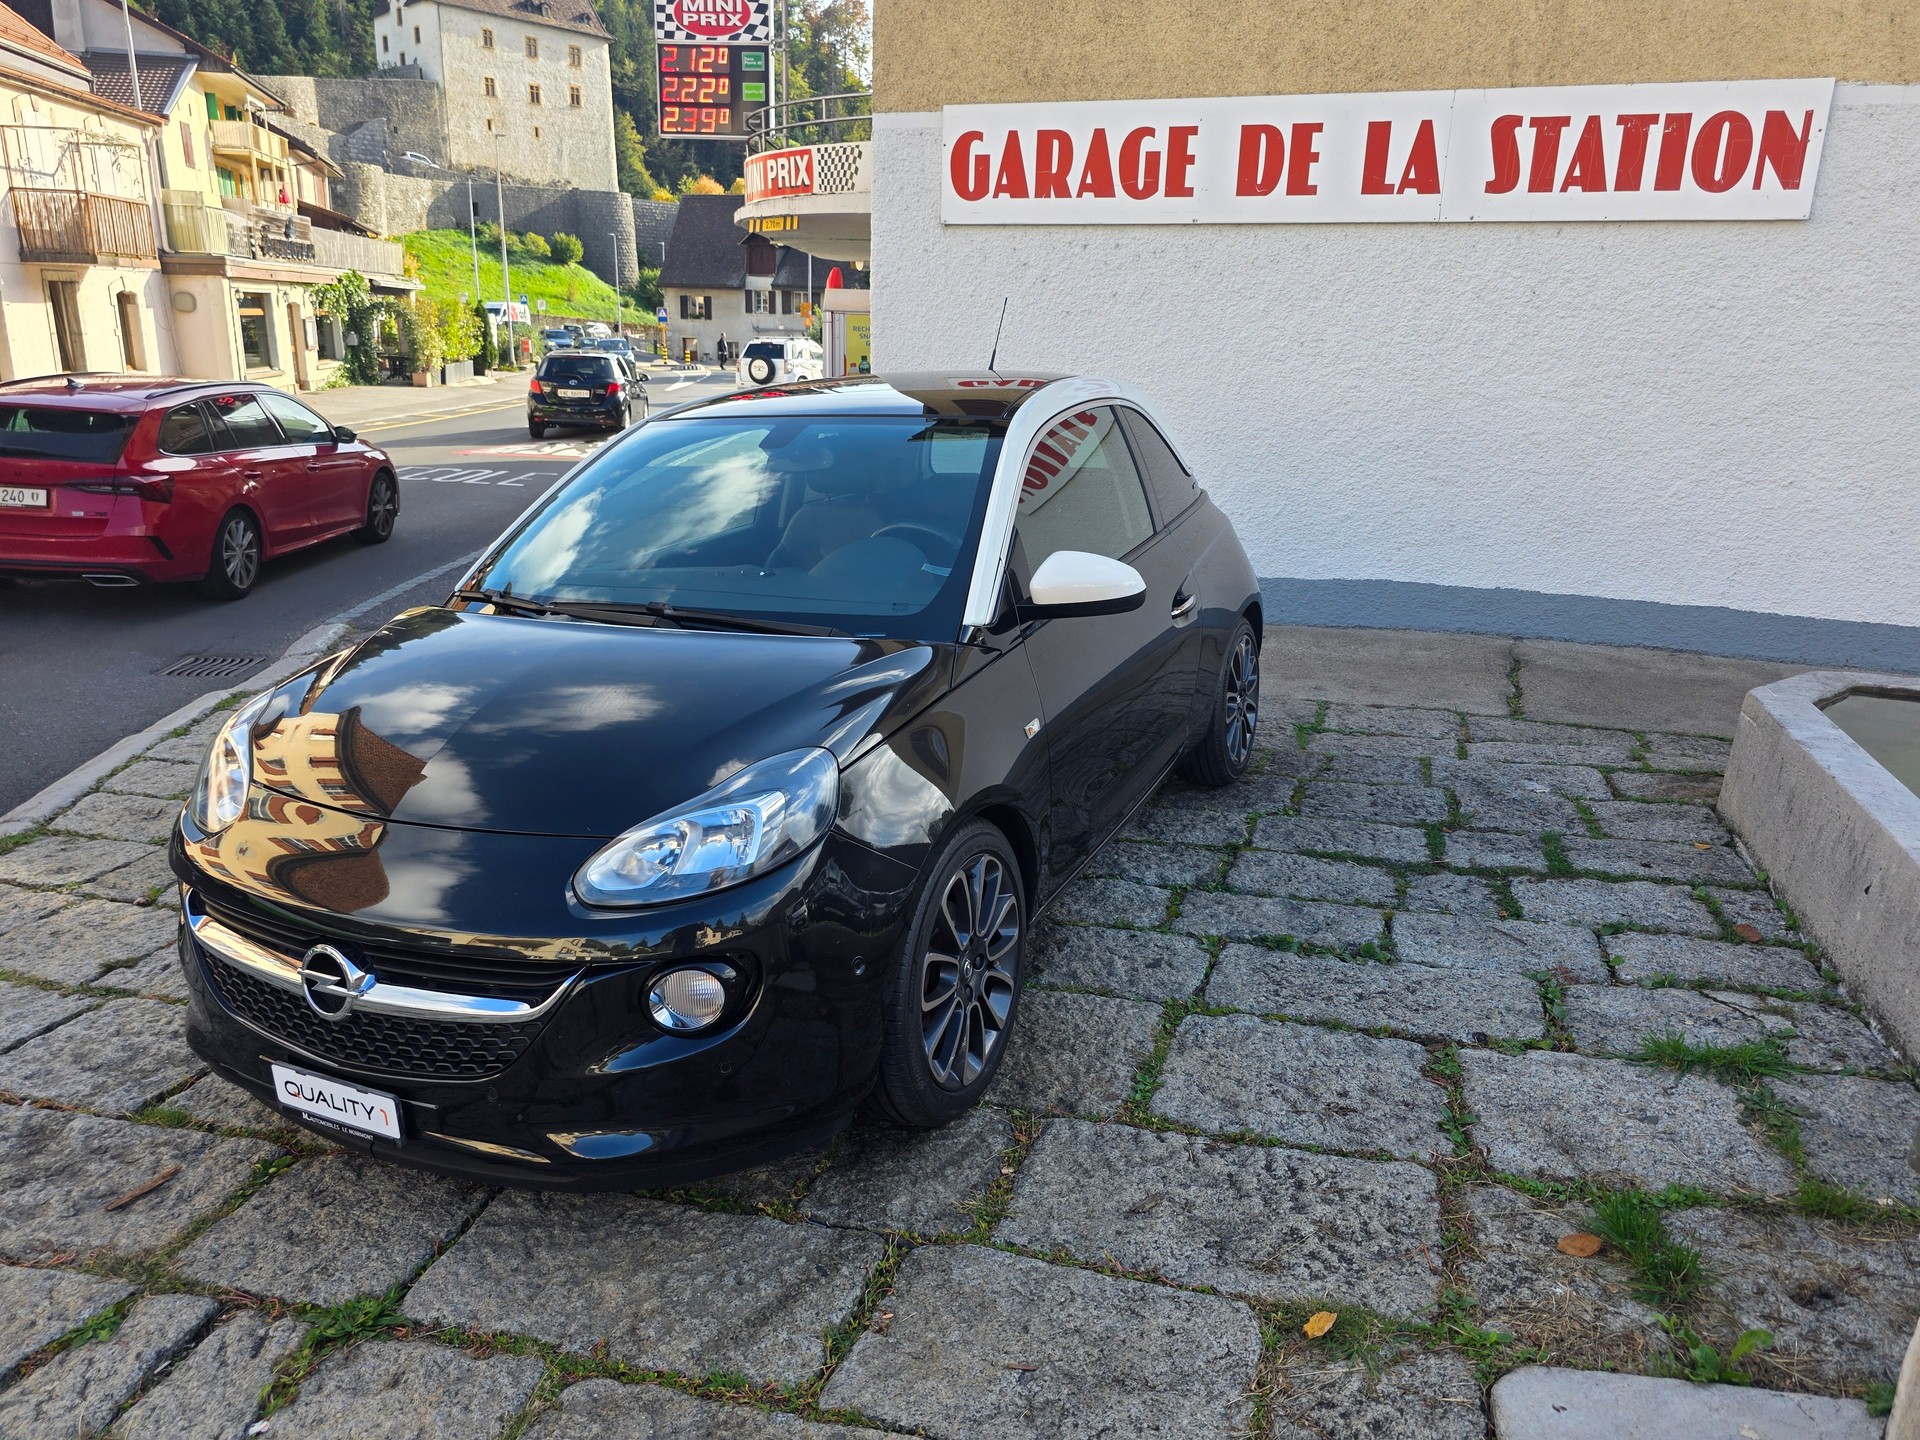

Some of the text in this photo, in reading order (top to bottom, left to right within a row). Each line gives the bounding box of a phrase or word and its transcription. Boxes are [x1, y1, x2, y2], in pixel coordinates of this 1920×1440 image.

[682, 0, 743, 12] MINI
[682, 13, 743, 27] PRIX
[950, 109, 1814, 201] GARAGE DE LA STATION
[766, 154, 811, 190] PRIX
[1, 489, 25, 502] 240
